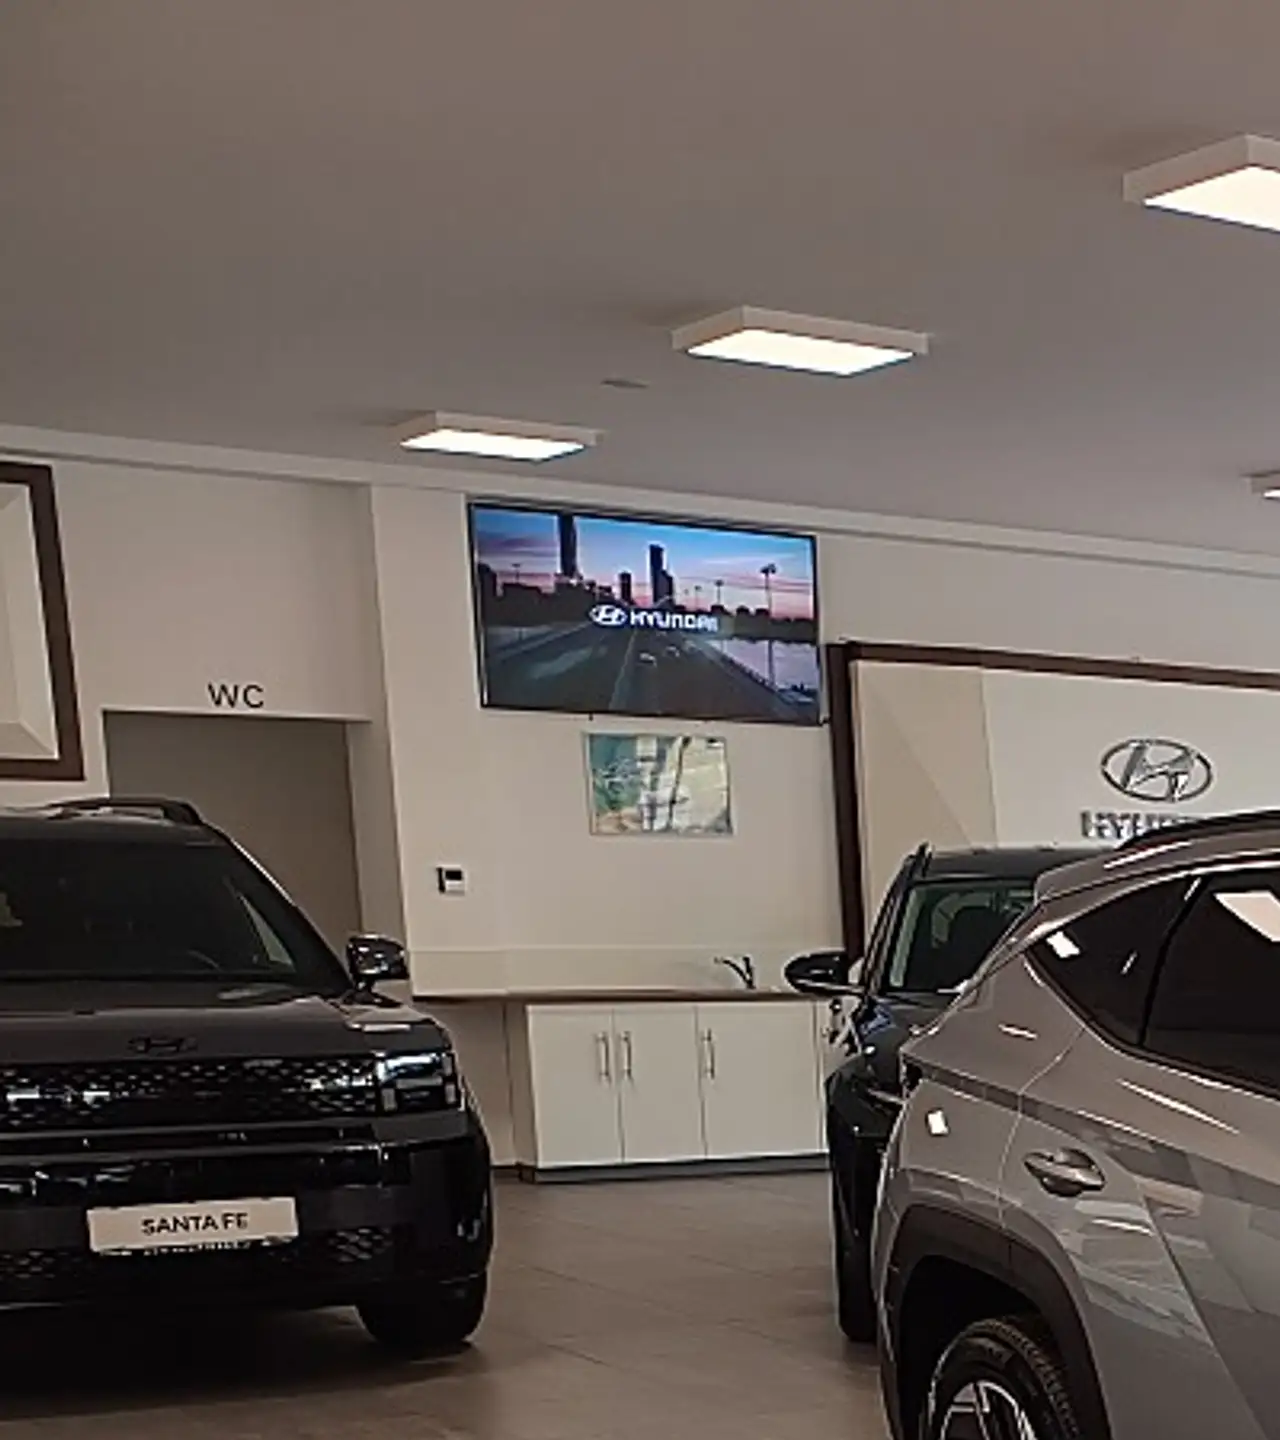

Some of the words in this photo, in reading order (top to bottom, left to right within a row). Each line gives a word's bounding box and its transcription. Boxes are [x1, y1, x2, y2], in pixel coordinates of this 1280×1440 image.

[630, 609, 719, 632] HYUNDAI
[207, 682, 264, 708] WC
[141, 1214, 219, 1236] SANTA
[221, 1212, 248, 1230] FE
